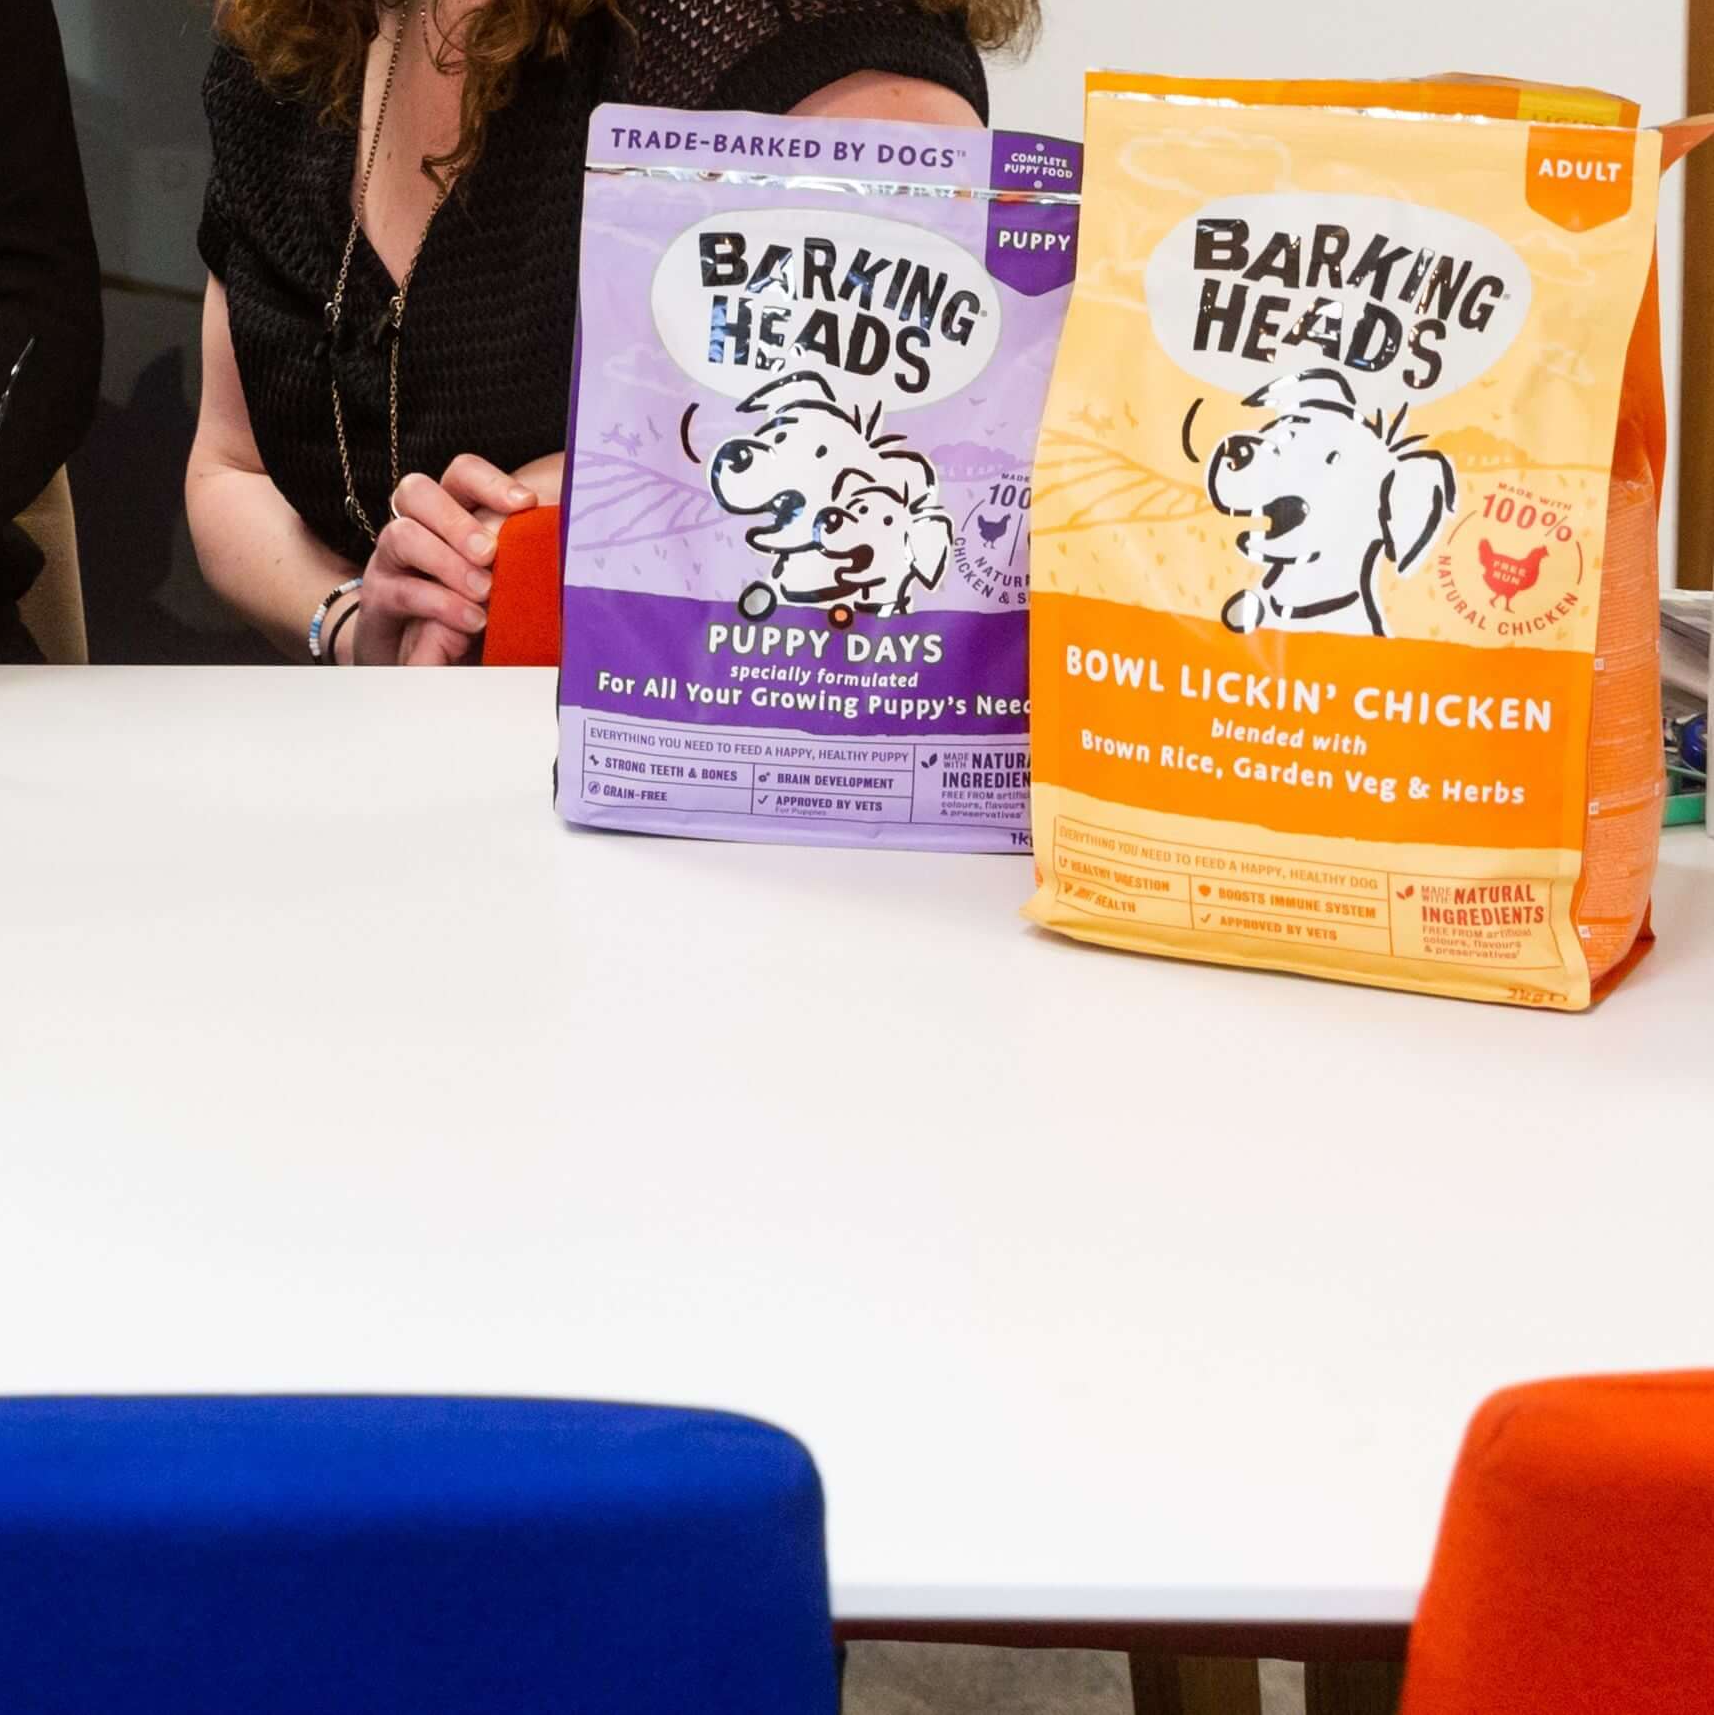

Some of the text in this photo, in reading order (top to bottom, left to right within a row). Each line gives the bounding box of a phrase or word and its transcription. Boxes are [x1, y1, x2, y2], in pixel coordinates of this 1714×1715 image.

[612, 128, 821, 158] TRADE-BARKED
[833, 142, 866, 162] BY
[1004, 163, 1073, 178] PUPPY FOOD
[1011, 152, 1068, 168] COMPLETE
[1538, 158, 1622, 182] ADULT
[999, 230, 1071, 251] PUPPY
[1194, 218, 1504, 333] BARKING
[699, 232, 981, 346] BARKING
[708, 294, 931, 394] HEADS
[1193, 278, 1447, 390] HEADS
[1498, 482, 1572, 511] MADE WITH
[1482, 493, 1572, 542] 100%
[954, 537, 994, 598] CHICKEN
[998, 591, 1009, 604] &
[1493, 560, 1527, 576] FREE
[1438, 555, 1486, 630] NATURAL
[1498, 592, 1578, 636] CHICKEN
[709, 624, 943, 663] PUPPY DAYS
[730, 665, 919, 687] specially formulated
[1066, 644, 1551, 733] BOWL LICKIN' CHICKEN
[598, 671, 635, 694] For
[643, 677, 677, 700] All
[686, 682, 742, 705] Your
[751, 687, 859, 719] Growing
[868, 695, 967, 720] Puppy's
[590, 727, 909, 763] EVERYTHING YOU NEED TO FEED A HAPPY, HEALTHY PUPPY
[1211, 717, 1368, 756] blended with
[943, 752, 969, 760] MADE
[943, 761, 967, 769] WITH
[1081, 729, 1525, 804] Brown Rice, Garden Veg & Herbs
[605, 757, 738, 782] STRONG TEETH & BONES
[777, 773, 894, 789] BRAIN DEVELOPMENT
[603, 784, 668, 802] GRAIN-FREE
[776, 795, 883, 812] APPROVED BY VETS
[942, 791, 966, 799] FREE
[967, 791, 993, 800] FROM
[1059, 825, 1378, 890] EVERYTHING YOU NEED TO FEED A HAPPY, HEALTHY DOG
[1218, 887, 1376, 919] BOOSTS IMMUNE SYSTEM
[1421, 885, 1451, 896] MADE
[1454, 884, 1536, 905] NATURAL
[1219, 915, 1337, 941] APPROVED BY VETS
[1421, 905, 1545, 926] INGREDIENTS
[1422, 925, 1450, 935] FREE
[1452, 927, 1483, 938] FROM
